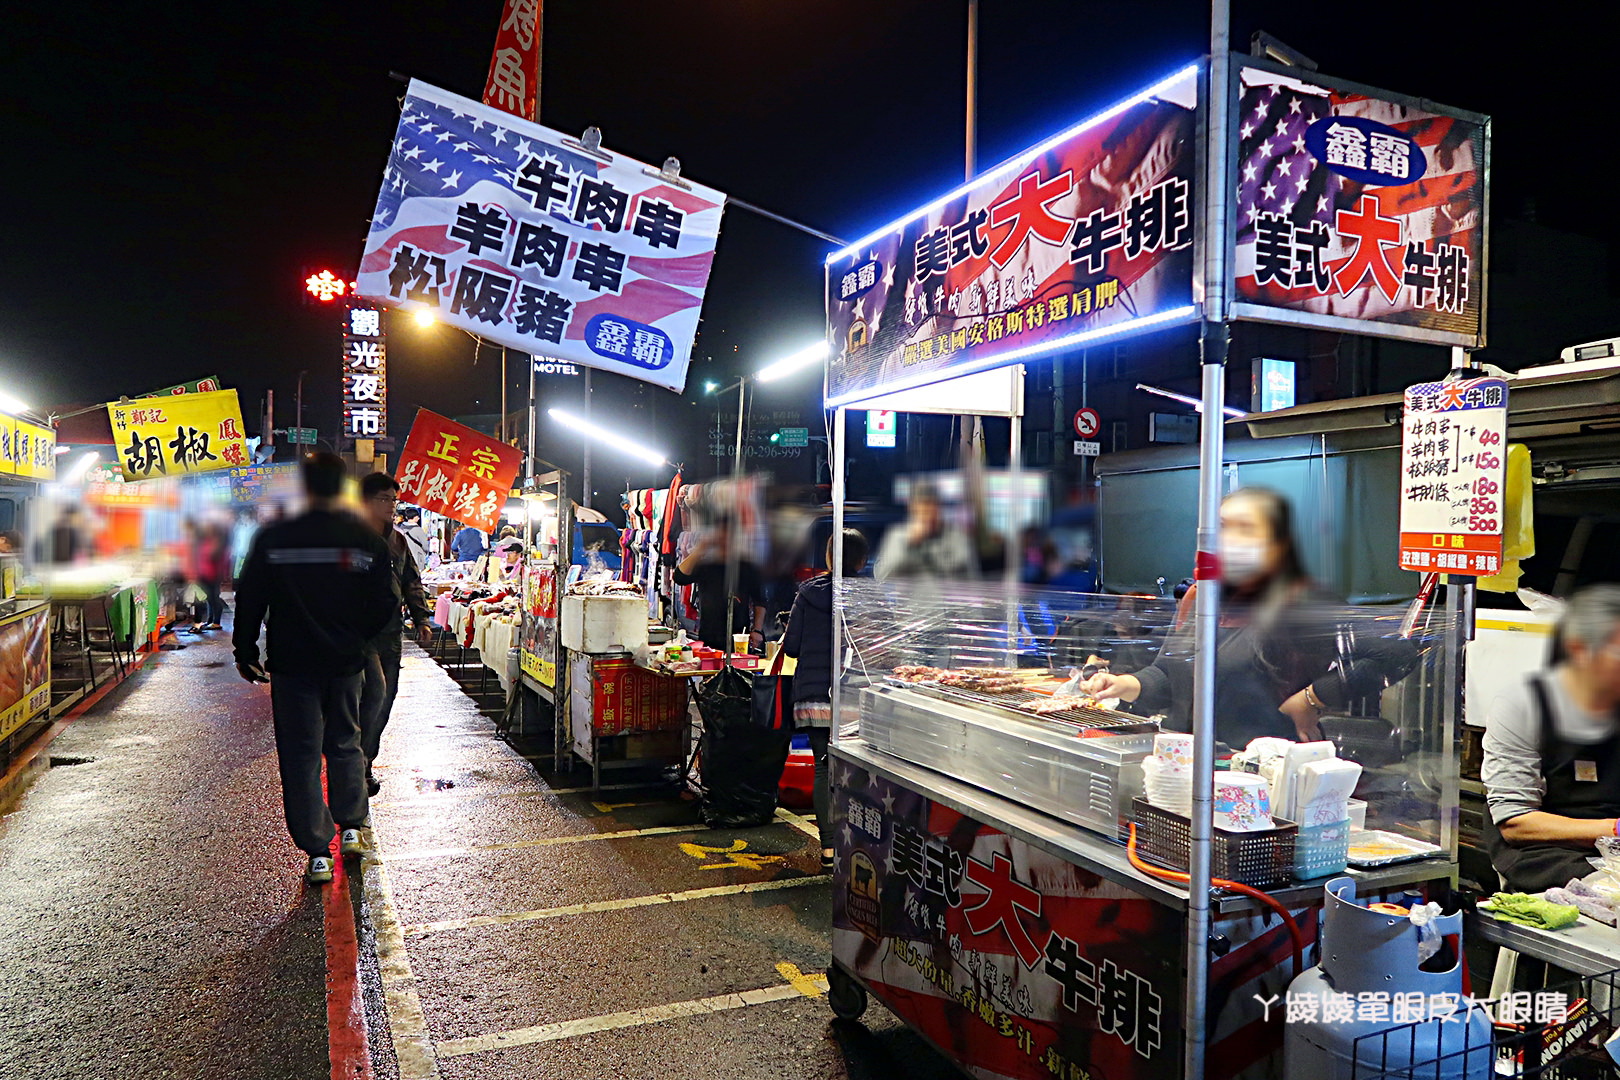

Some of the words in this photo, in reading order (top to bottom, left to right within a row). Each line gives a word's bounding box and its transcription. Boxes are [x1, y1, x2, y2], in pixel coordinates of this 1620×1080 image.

[1326, 122, 1410, 179] 鑫霸
[517, 157, 684, 249] 牛肉串
[915, 170, 1190, 283] 美式大牛排
[450, 202, 626, 293] 羊肉串
[1255, 194, 1470, 314] 美式大牛排
[388, 245, 573, 344] 松阪豬
[841, 262, 876, 298] 鑫霸
[594, 319, 666, 367] 鑫霸
[350, 308, 380, 434] 觀光夜市
[534, 363, 579, 375] MOTEL
[115, 409, 127, 431] 新竹
[130, 409, 168, 426] 鄭記
[1411, 385, 1501, 411] 美式大牛排
[124, 426, 218, 476] 胡椒
[219, 418, 246, 466] 鳳螺
[728, 446, 801, 458] 000-296-999
[1411, 417, 1450, 439] 牛肉串
[1411, 438, 1449, 459] 羊肉串
[427, 431, 501, 480] 正宗
[400, 460, 499, 527] 剁椒烤魚
[1432, 534, 1464, 548] 口味
[848, 798, 881, 840] 鑫霸
[892, 822, 1162, 1059] 美式大牛排
